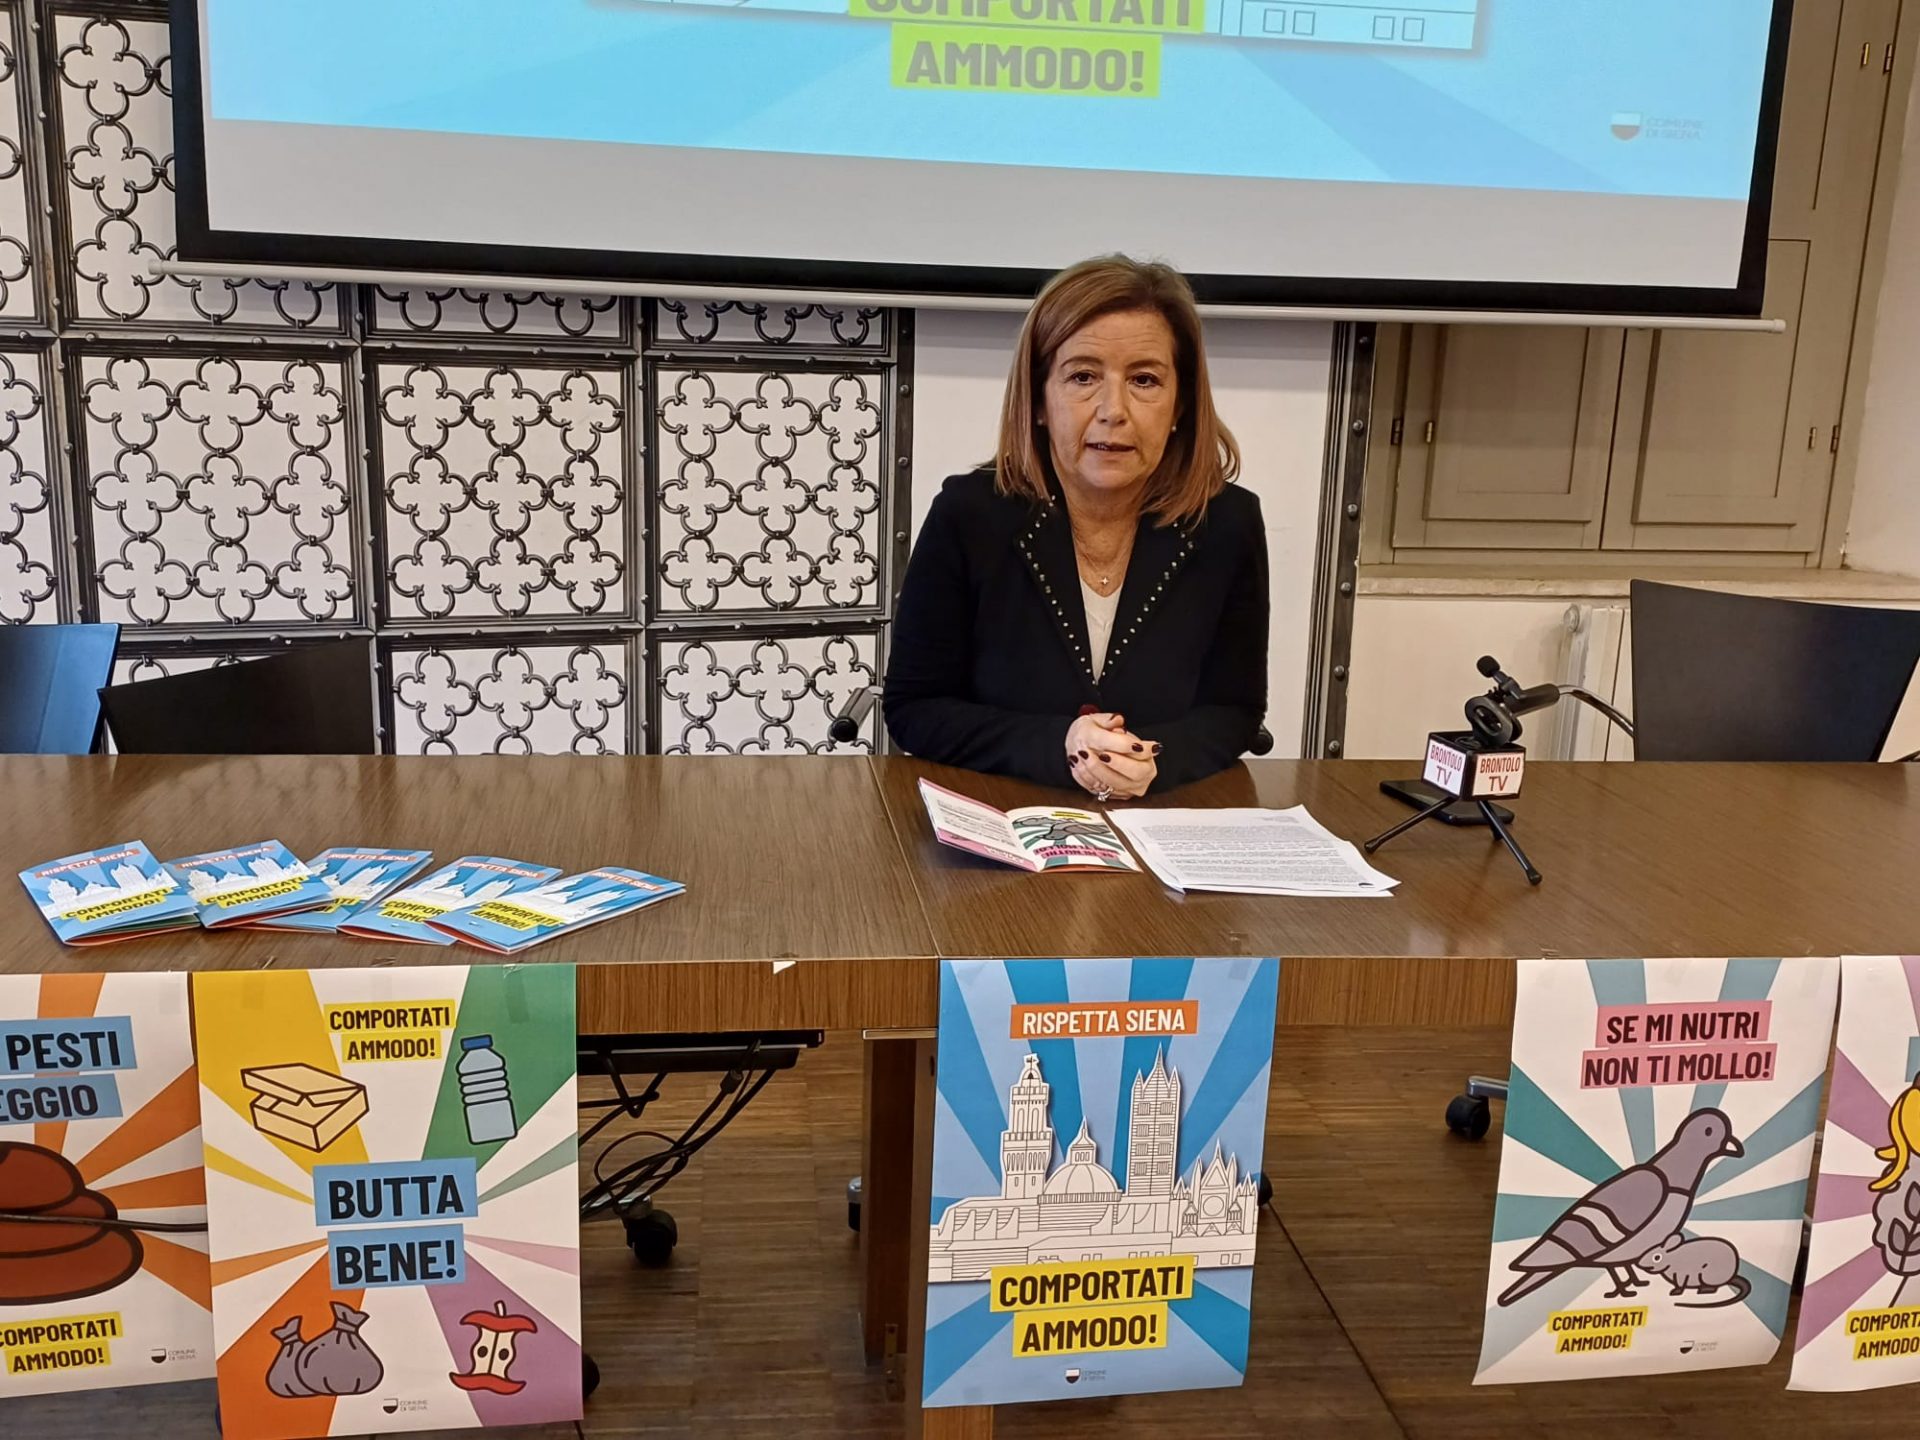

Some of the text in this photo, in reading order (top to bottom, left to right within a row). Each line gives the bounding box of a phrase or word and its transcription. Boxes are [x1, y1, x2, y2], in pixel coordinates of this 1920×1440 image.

[905, 40, 1144, 93] AMMODO!
[1430, 745, 1462, 772] BRONTOLO
[1480, 757, 1521, 774] BRONTOLO
[1436, 765, 1452, 785] TV
[1489, 775, 1508, 791] TV
[41, 851, 135, 876] RISPETTA SIENA
[206, 877, 304, 903] COMPORTATI
[226, 886, 298, 906] AMMODO!
[66, 889, 168, 918] COMPORTATI
[86, 898, 161, 921] AMMODO!
[482, 902, 559, 925] COMPORTATI
[330, 1007, 450, 1030] COMPORTATI
[1023, 1008, 1185, 1035] RISPETTA SIENA
[1606, 1011, 1760, 1044] SE MI NUTRI
[5, 1031, 121, 1071] PESTI
[347, 1038, 435, 1060] AMMODO!
[1584, 1052, 1771, 1086] NON TI MOLLO!
[328, 1175, 464, 1220] BUTTA
[336, 1239, 457, 1285] BENE!
[1000, 1266, 1184, 1306] COMPORTATI
[1021, 1314, 1157, 1352] AMMODO!
[1552, 1311, 1644, 1331] COMPORTATI
[1850, 1311, 1920, 1333] COMPORT
[1560, 1334, 1627, 1353] AMMODO!
[13, 1347, 105, 1373] AMMODO!
